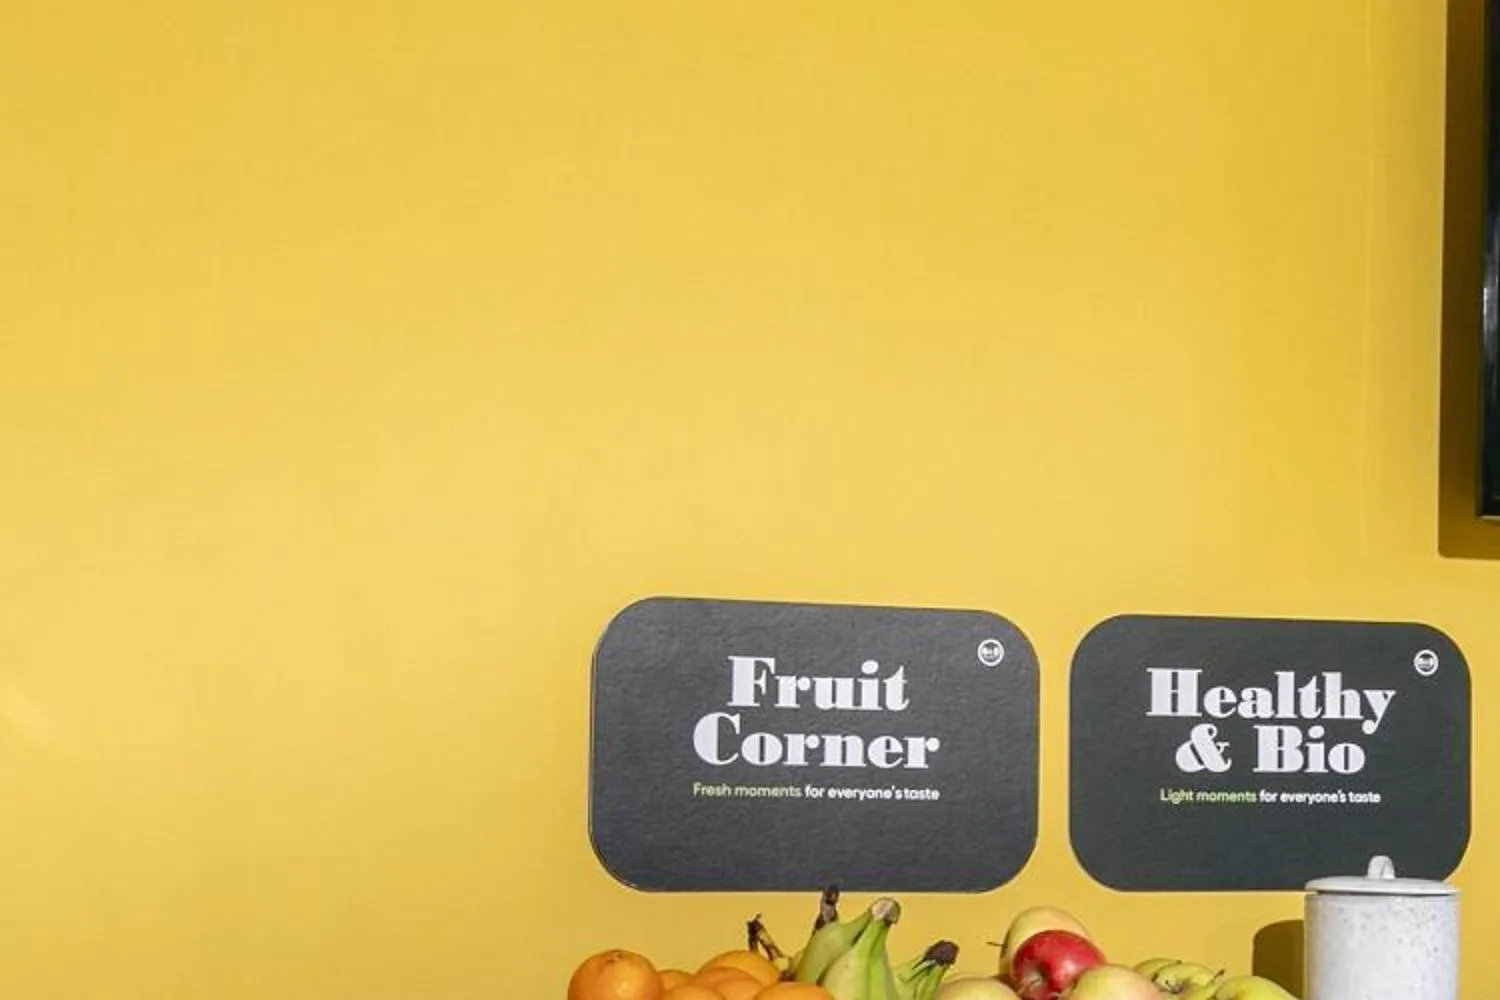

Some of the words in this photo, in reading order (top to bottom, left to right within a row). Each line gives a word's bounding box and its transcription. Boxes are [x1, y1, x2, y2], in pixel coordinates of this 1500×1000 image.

[726, 654, 910, 713] Fruit
[1145, 667, 1397, 735] Healthy
[692, 709, 941, 771] Corner
[1174, 723, 1232, 774] &
[1253, 722, 1367, 775] Bio
[693, 782, 732, 798] Fresh
[734, 785, 802, 799] moments
[804, 784, 826, 799] for
[827, 785, 903, 801] everyone's
[903, 786, 941, 801] taste
[1159, 788, 1194, 805] Light
[1196, 791, 1257, 804] moments
[1258, 789, 1279, 803] for
[1280, 790, 1346, 805] everyone's
[1348, 791, 1382, 804] taste
